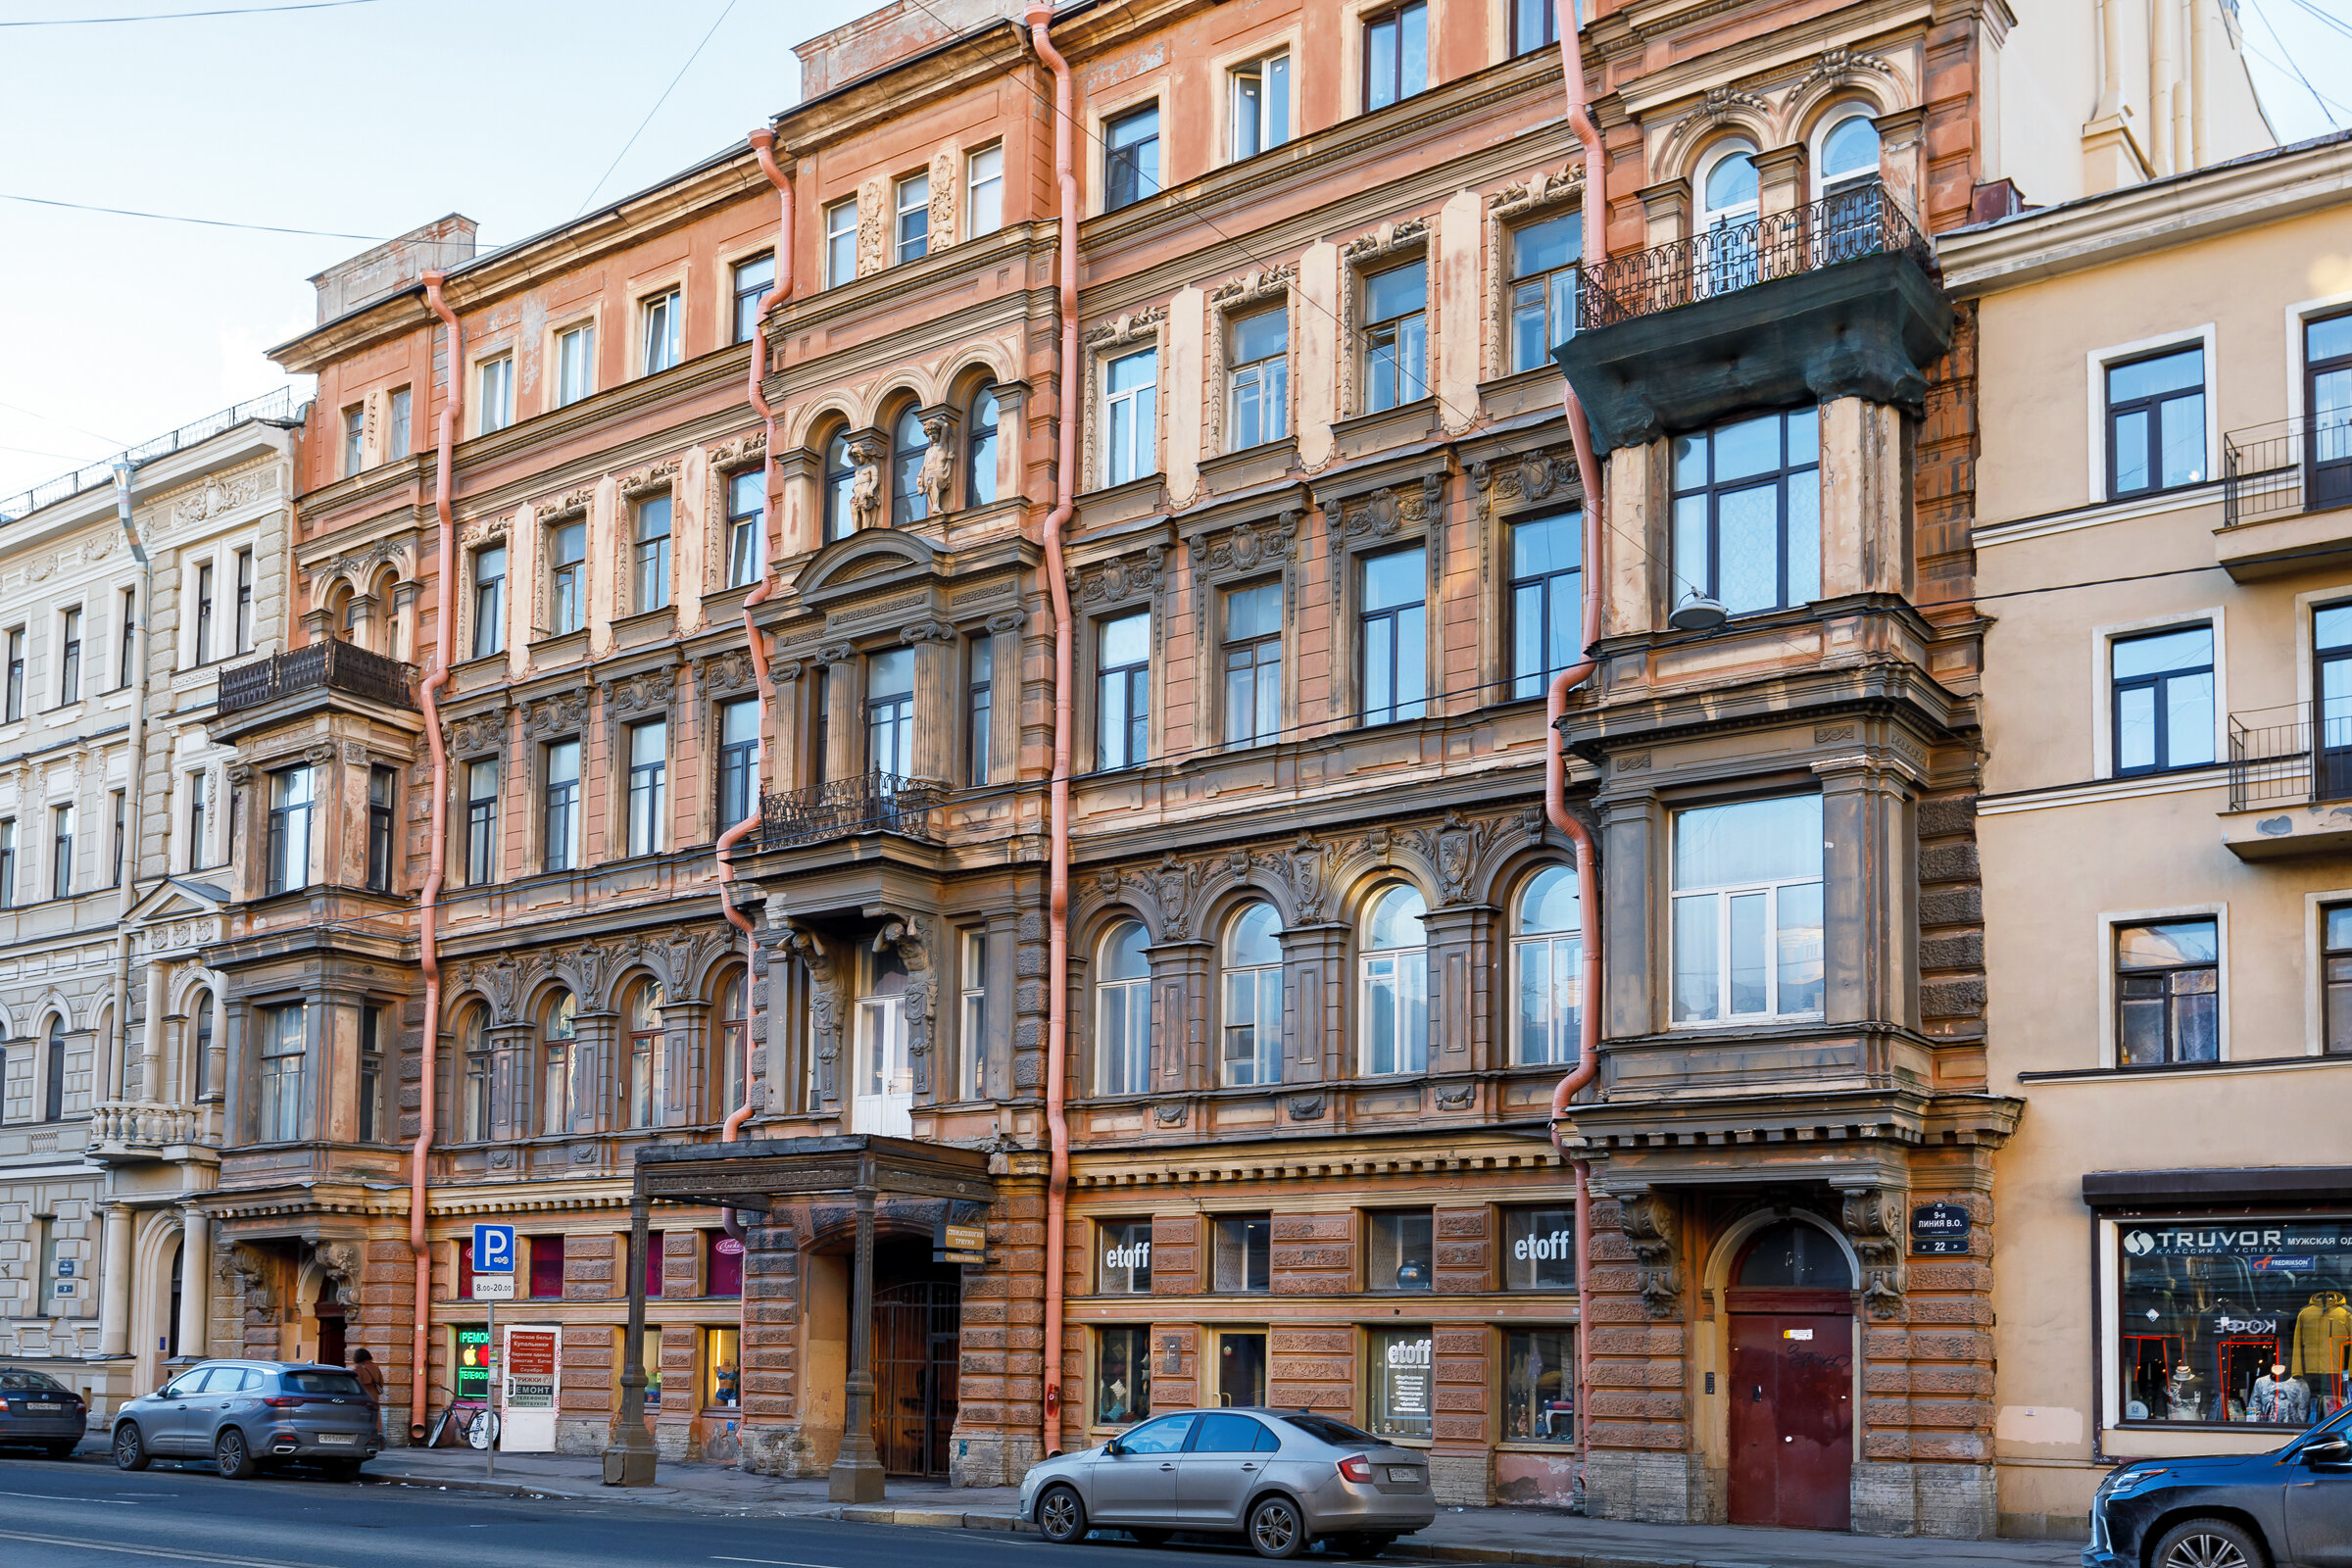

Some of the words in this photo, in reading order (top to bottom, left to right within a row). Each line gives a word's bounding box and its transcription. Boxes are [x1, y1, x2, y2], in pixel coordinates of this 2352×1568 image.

[947, 1229, 984, 1238] СТОМАТОЛОГИЯ
[2157, 1230, 2281, 1247] TRUVOR
[2287, 1237, 2335, 1246] МУЖСКАЯ
[1514, 1230, 1570, 1260] etoff
[1935, 1242, 1945, 1251] 22
[1106, 1242, 1150, 1268] etoff
[1388, 1339, 1432, 1364] etoff
